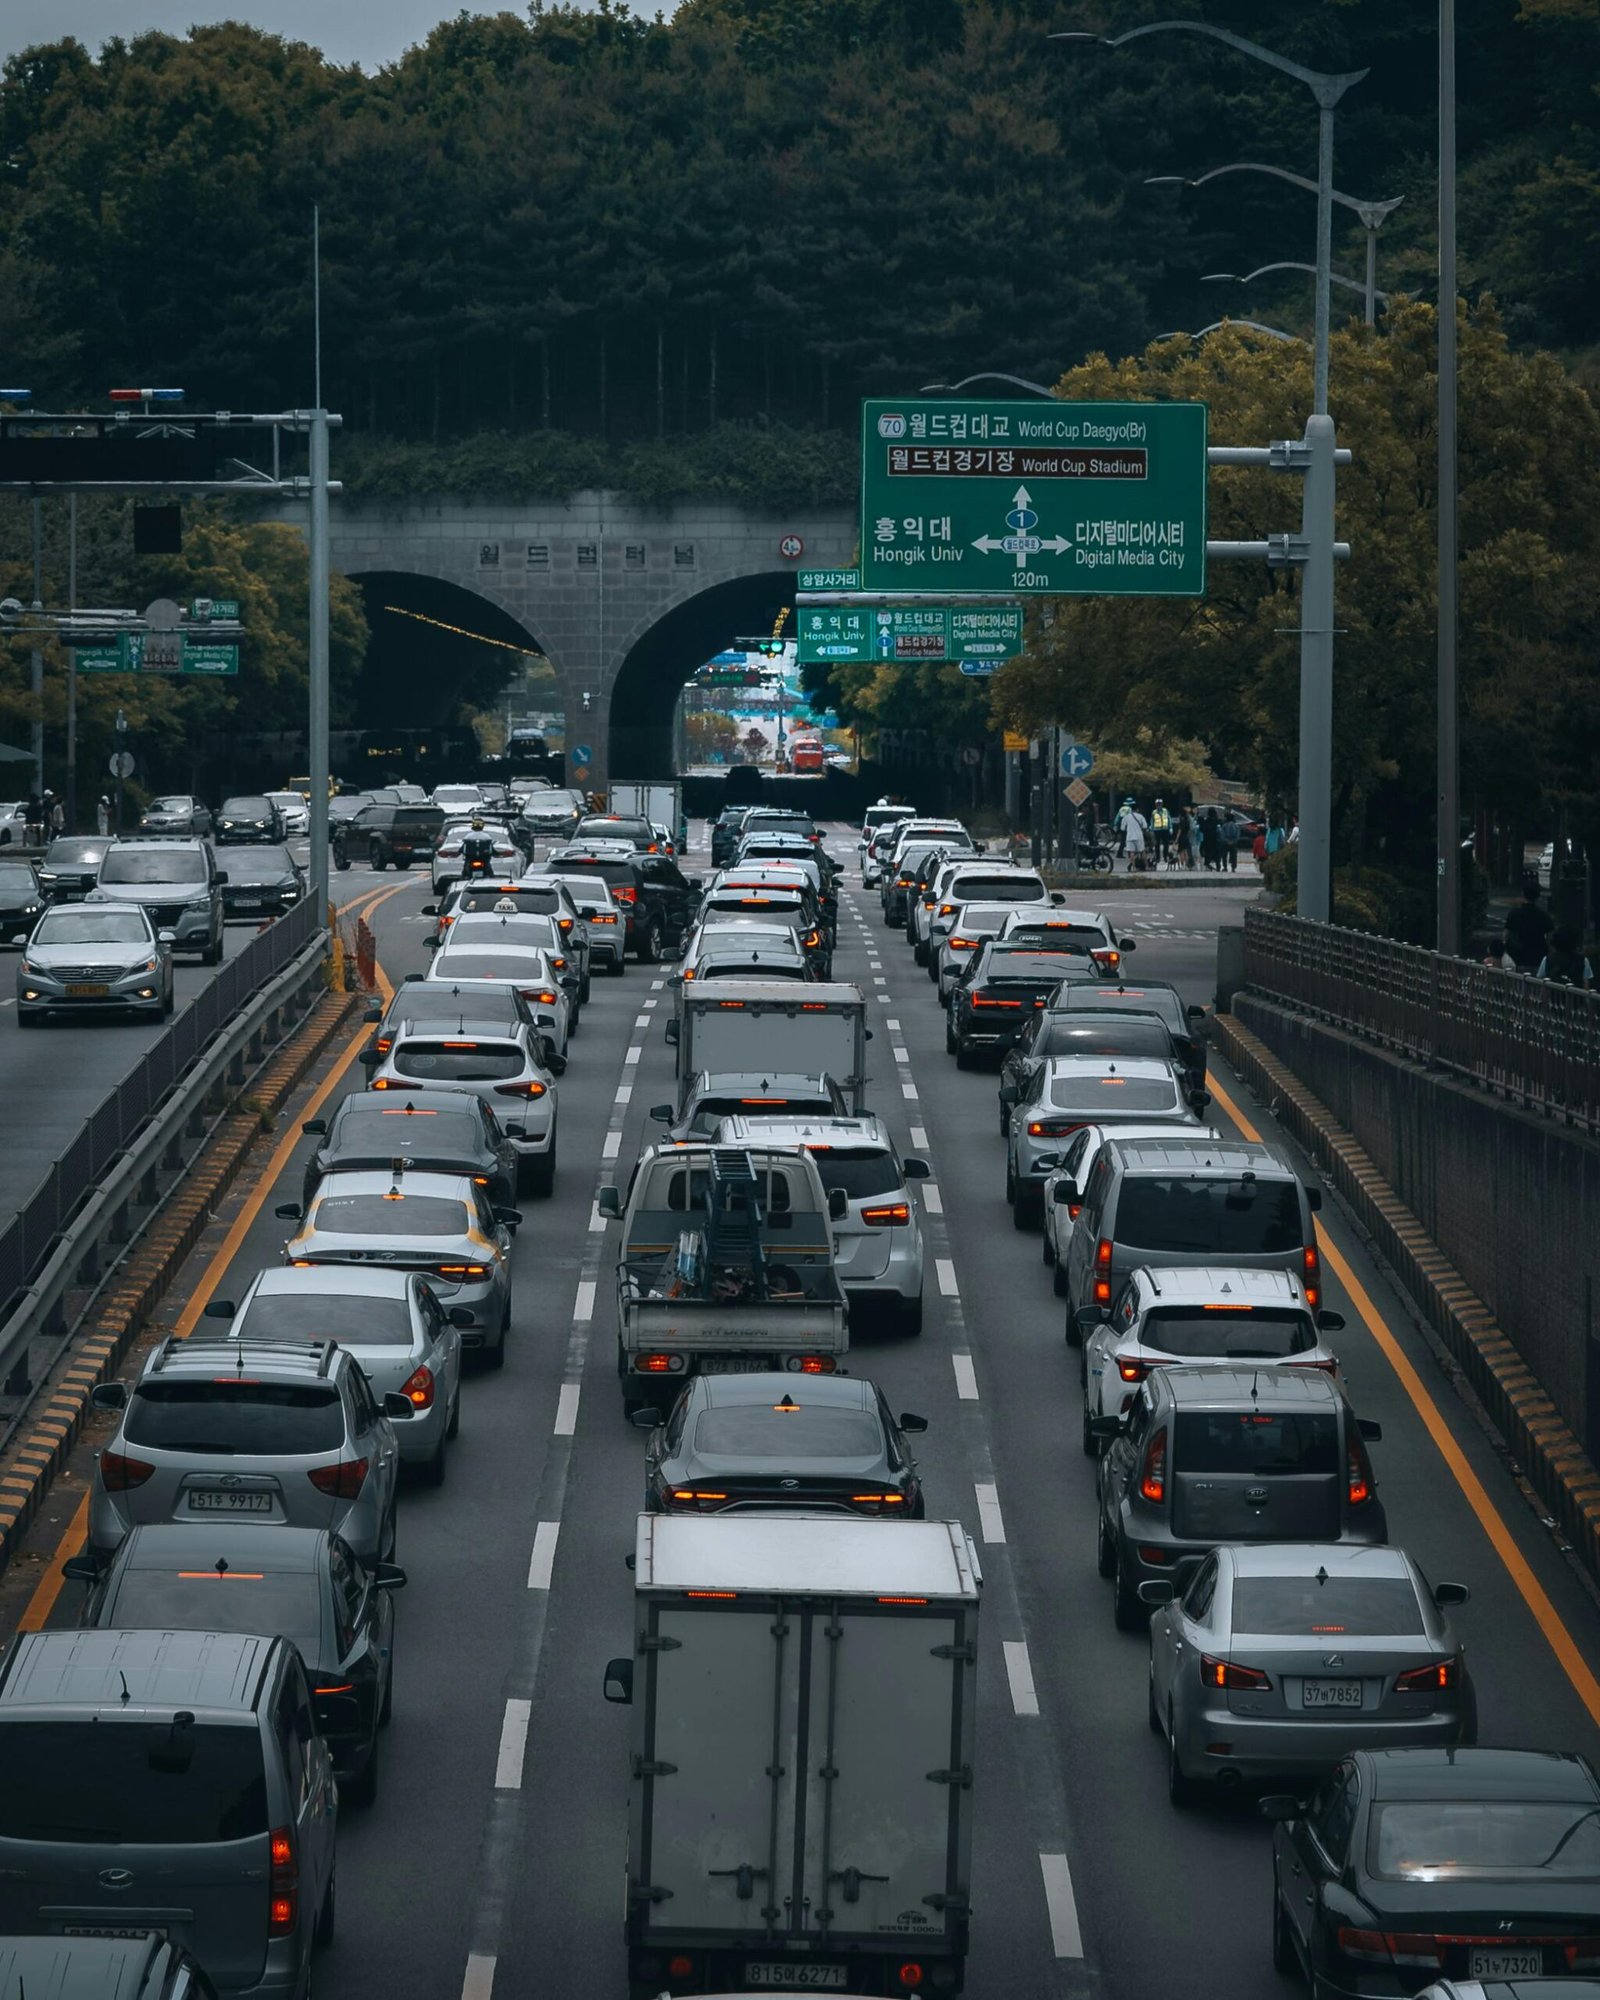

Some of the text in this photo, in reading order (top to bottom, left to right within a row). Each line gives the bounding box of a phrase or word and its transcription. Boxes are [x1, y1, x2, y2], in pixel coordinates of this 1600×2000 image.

[884, 413, 1147, 441] 70 월드컵대교 World Cup Daegyo(Br)
[890, 449, 1143, 475] 월드컵경기장 World Cup Stadium
[1017, 512, 1024, 527] 1
[1076, 520, 1185, 547] 디지털미디어시티
[874, 546, 963, 565] Hongik Univ
[1076, 549, 1185, 568] Digital Media City
[802, 573, 856, 586] 상암사거리
[1011, 573, 1049, 587] 120m
[894, 612, 944, 624] 월드컵대교
[953, 614, 1018, 628] 디지털미디어시티
[804, 631, 865, 642] Hongik Univ
[953, 629, 1017, 640] Digital Media City
[229, 1495, 264, 1507] 9917
